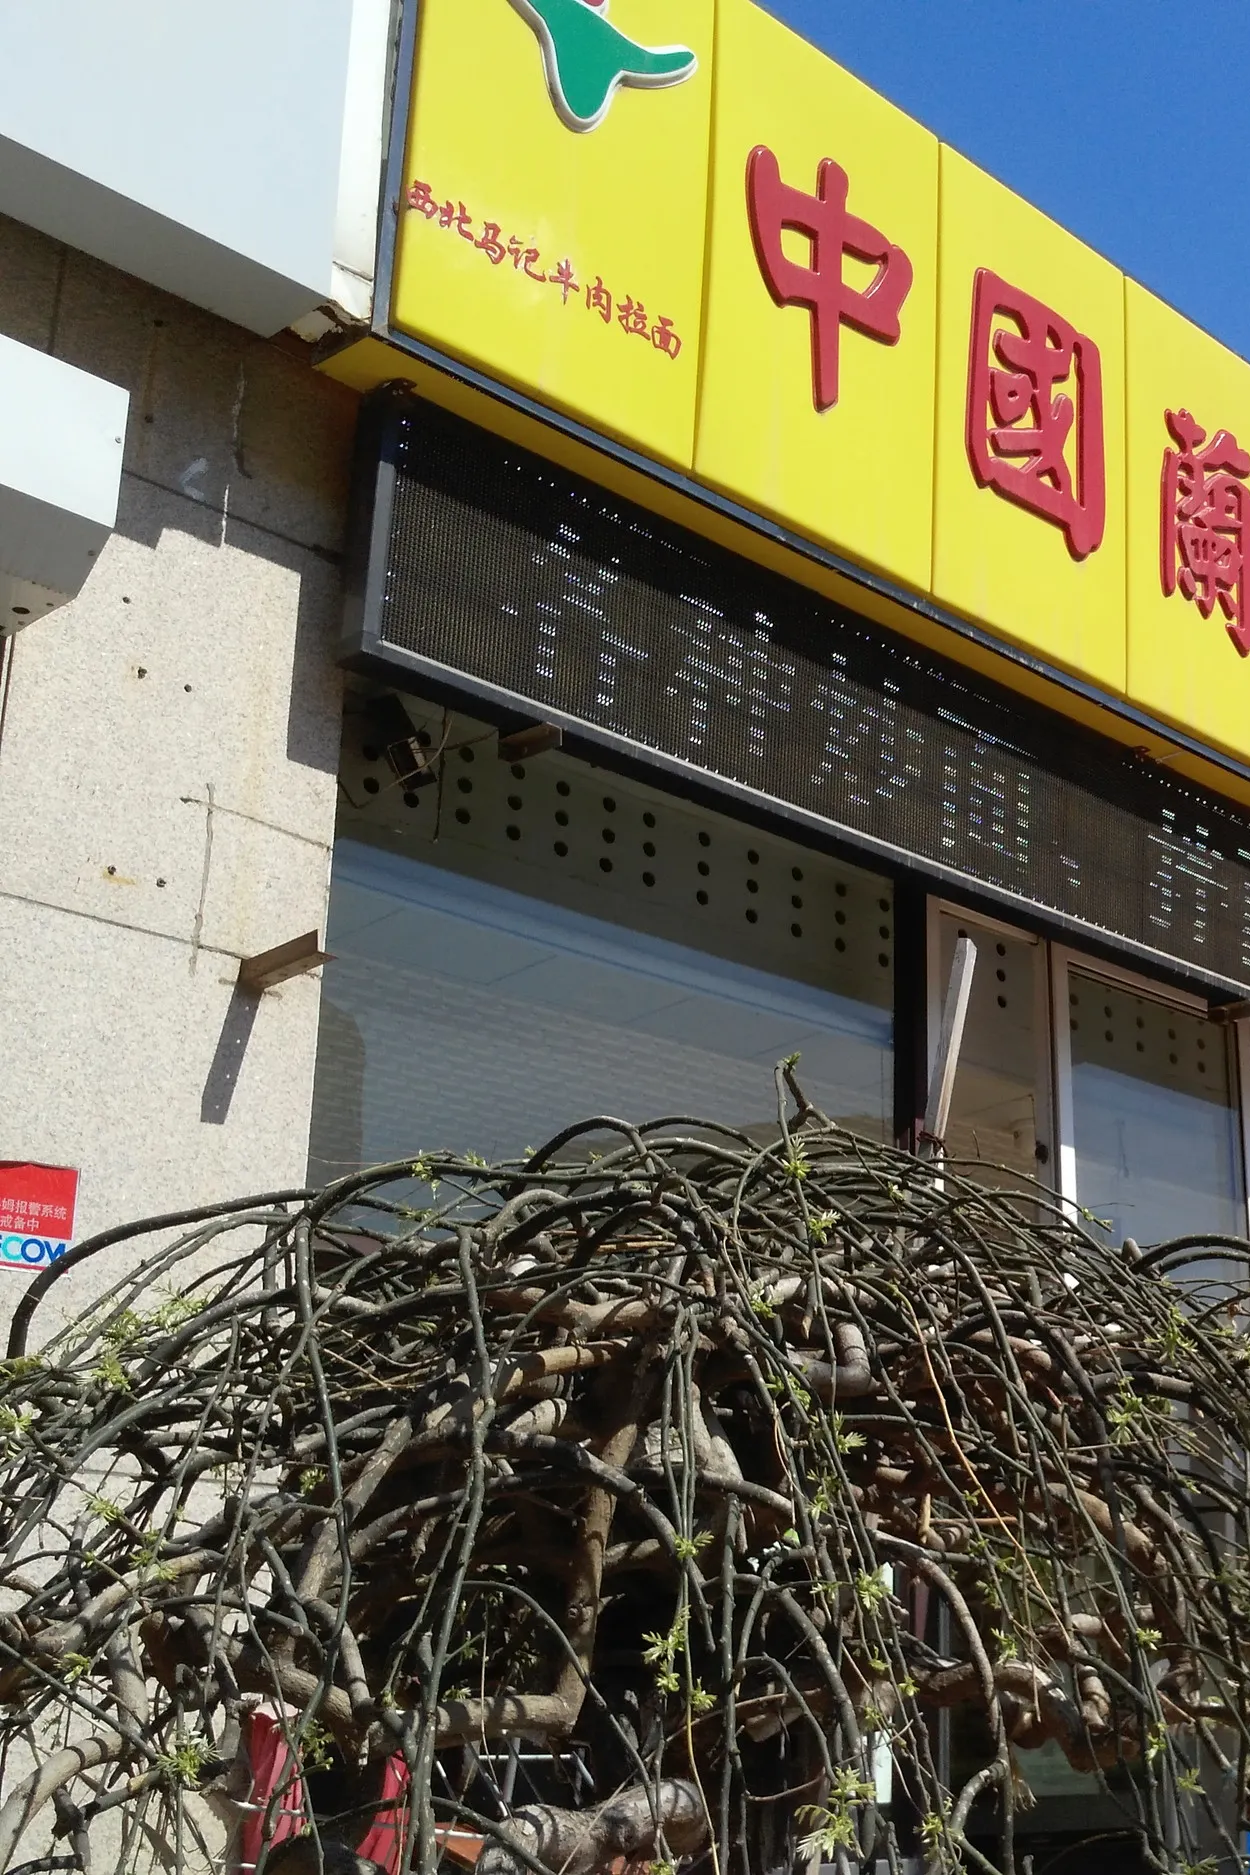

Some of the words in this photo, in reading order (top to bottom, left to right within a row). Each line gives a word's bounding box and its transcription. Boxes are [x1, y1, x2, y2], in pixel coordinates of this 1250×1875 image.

[405, 179, 682, 360] 西北马记牛肉拉面
[0, 1197, 67, 1220] 姆报警系统
